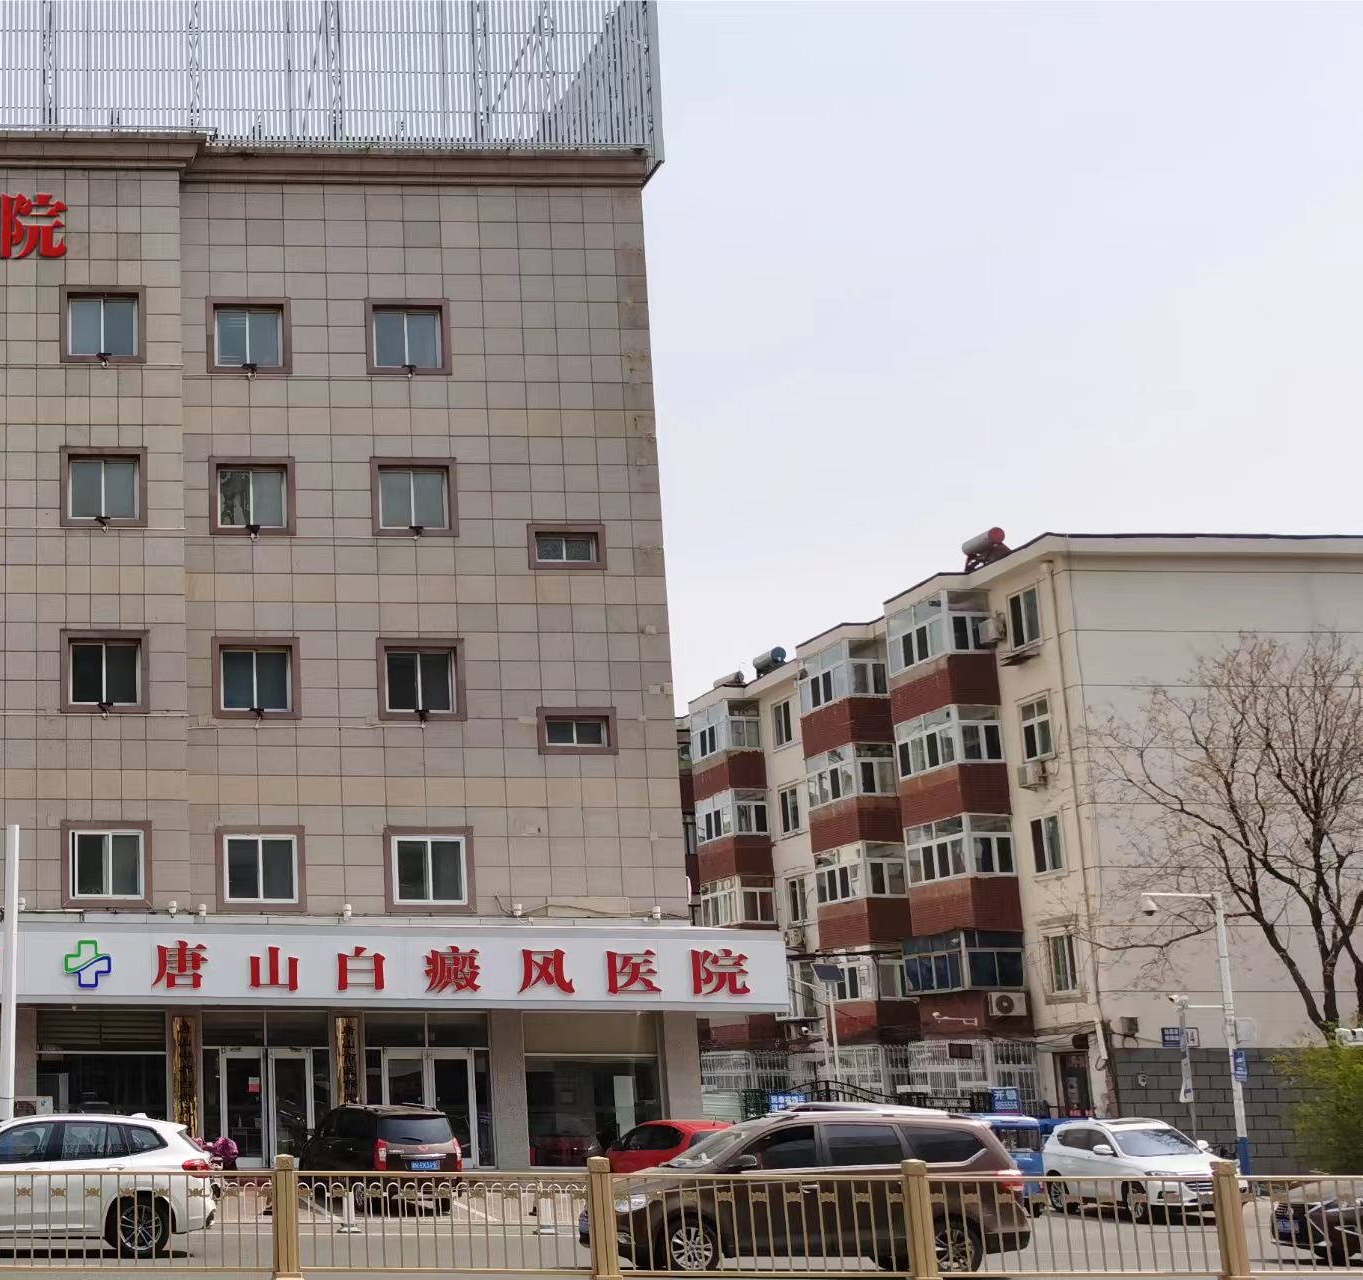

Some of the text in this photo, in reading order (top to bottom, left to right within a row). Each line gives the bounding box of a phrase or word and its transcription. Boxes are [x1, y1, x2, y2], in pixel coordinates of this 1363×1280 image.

[151, 939, 750, 997] 唐山白癜风医院
